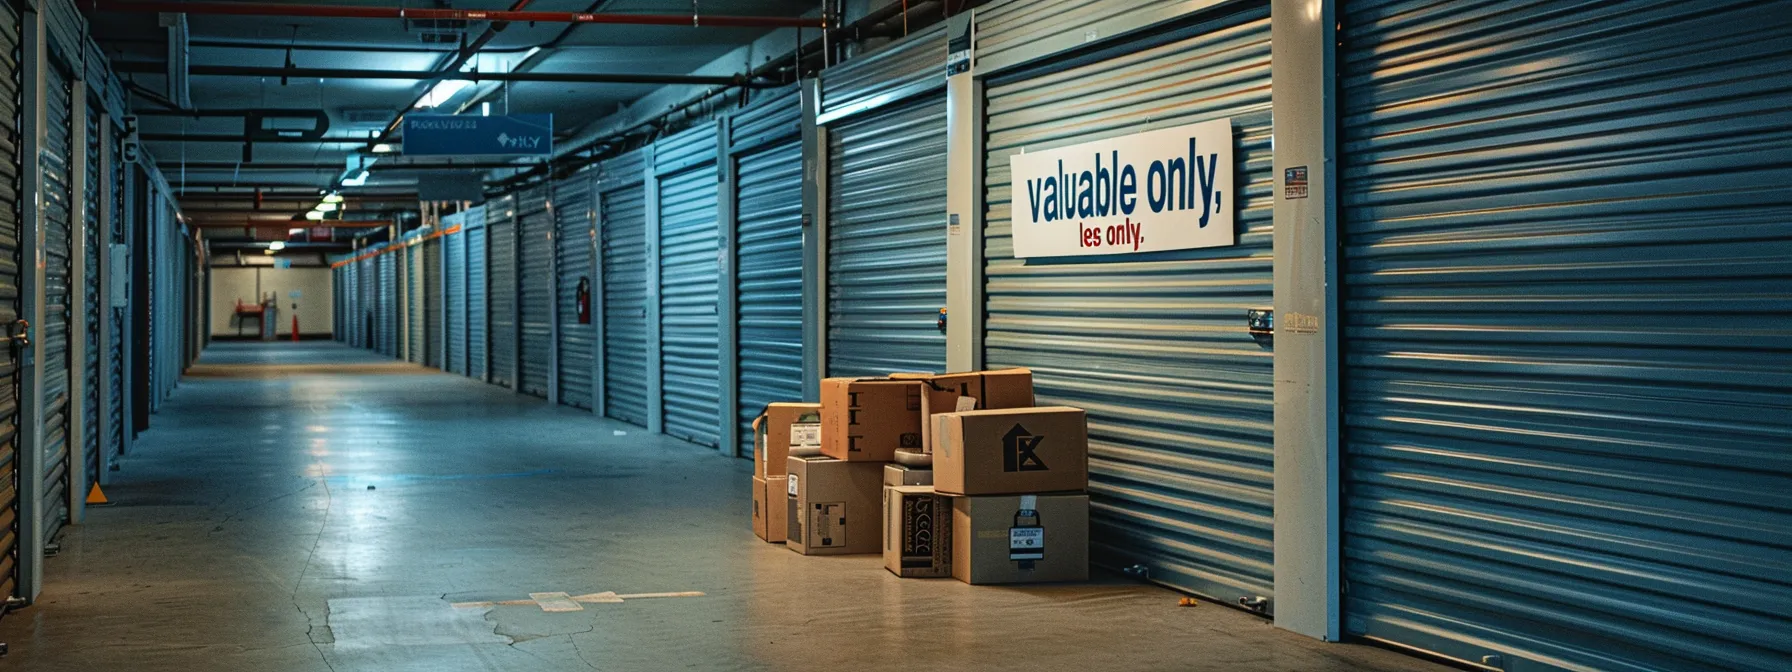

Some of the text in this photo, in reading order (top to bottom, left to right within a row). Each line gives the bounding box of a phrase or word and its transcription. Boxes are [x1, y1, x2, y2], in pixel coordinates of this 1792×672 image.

[1027, 137, 1222, 229] valuable only,
[1079, 222, 1101, 248] les
